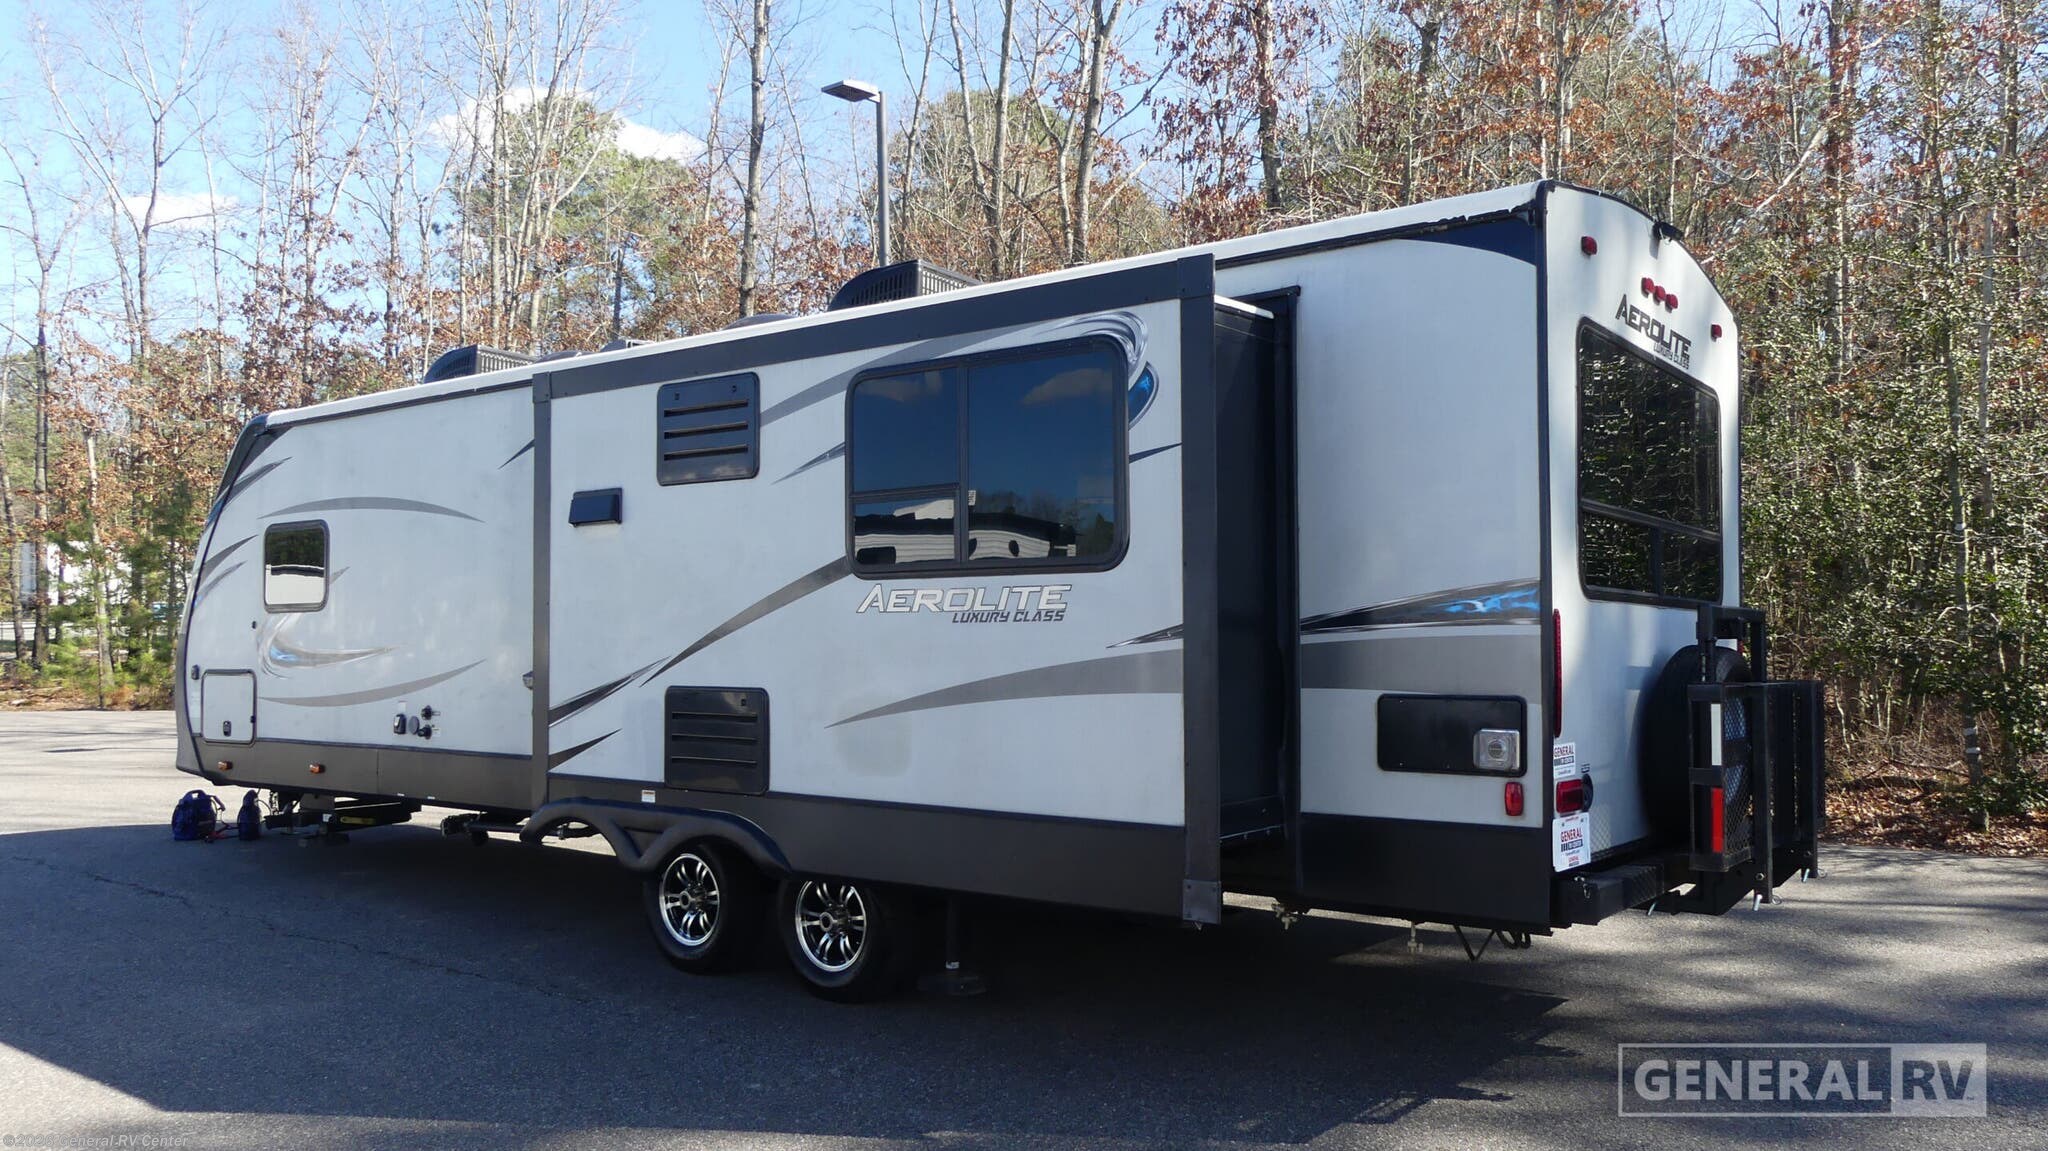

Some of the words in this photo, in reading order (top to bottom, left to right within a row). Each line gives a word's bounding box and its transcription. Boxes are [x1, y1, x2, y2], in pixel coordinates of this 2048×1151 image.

[1615, 294, 1691, 358] AEROLITE
[856, 583, 1072, 613] AEROLITE
[952, 611, 1010, 623] LUXURY
[1012, 610, 1065, 622] CLASS
[1554, 744, 1575, 758] GENERAL
[1561, 827, 1583, 843] GENERAL
